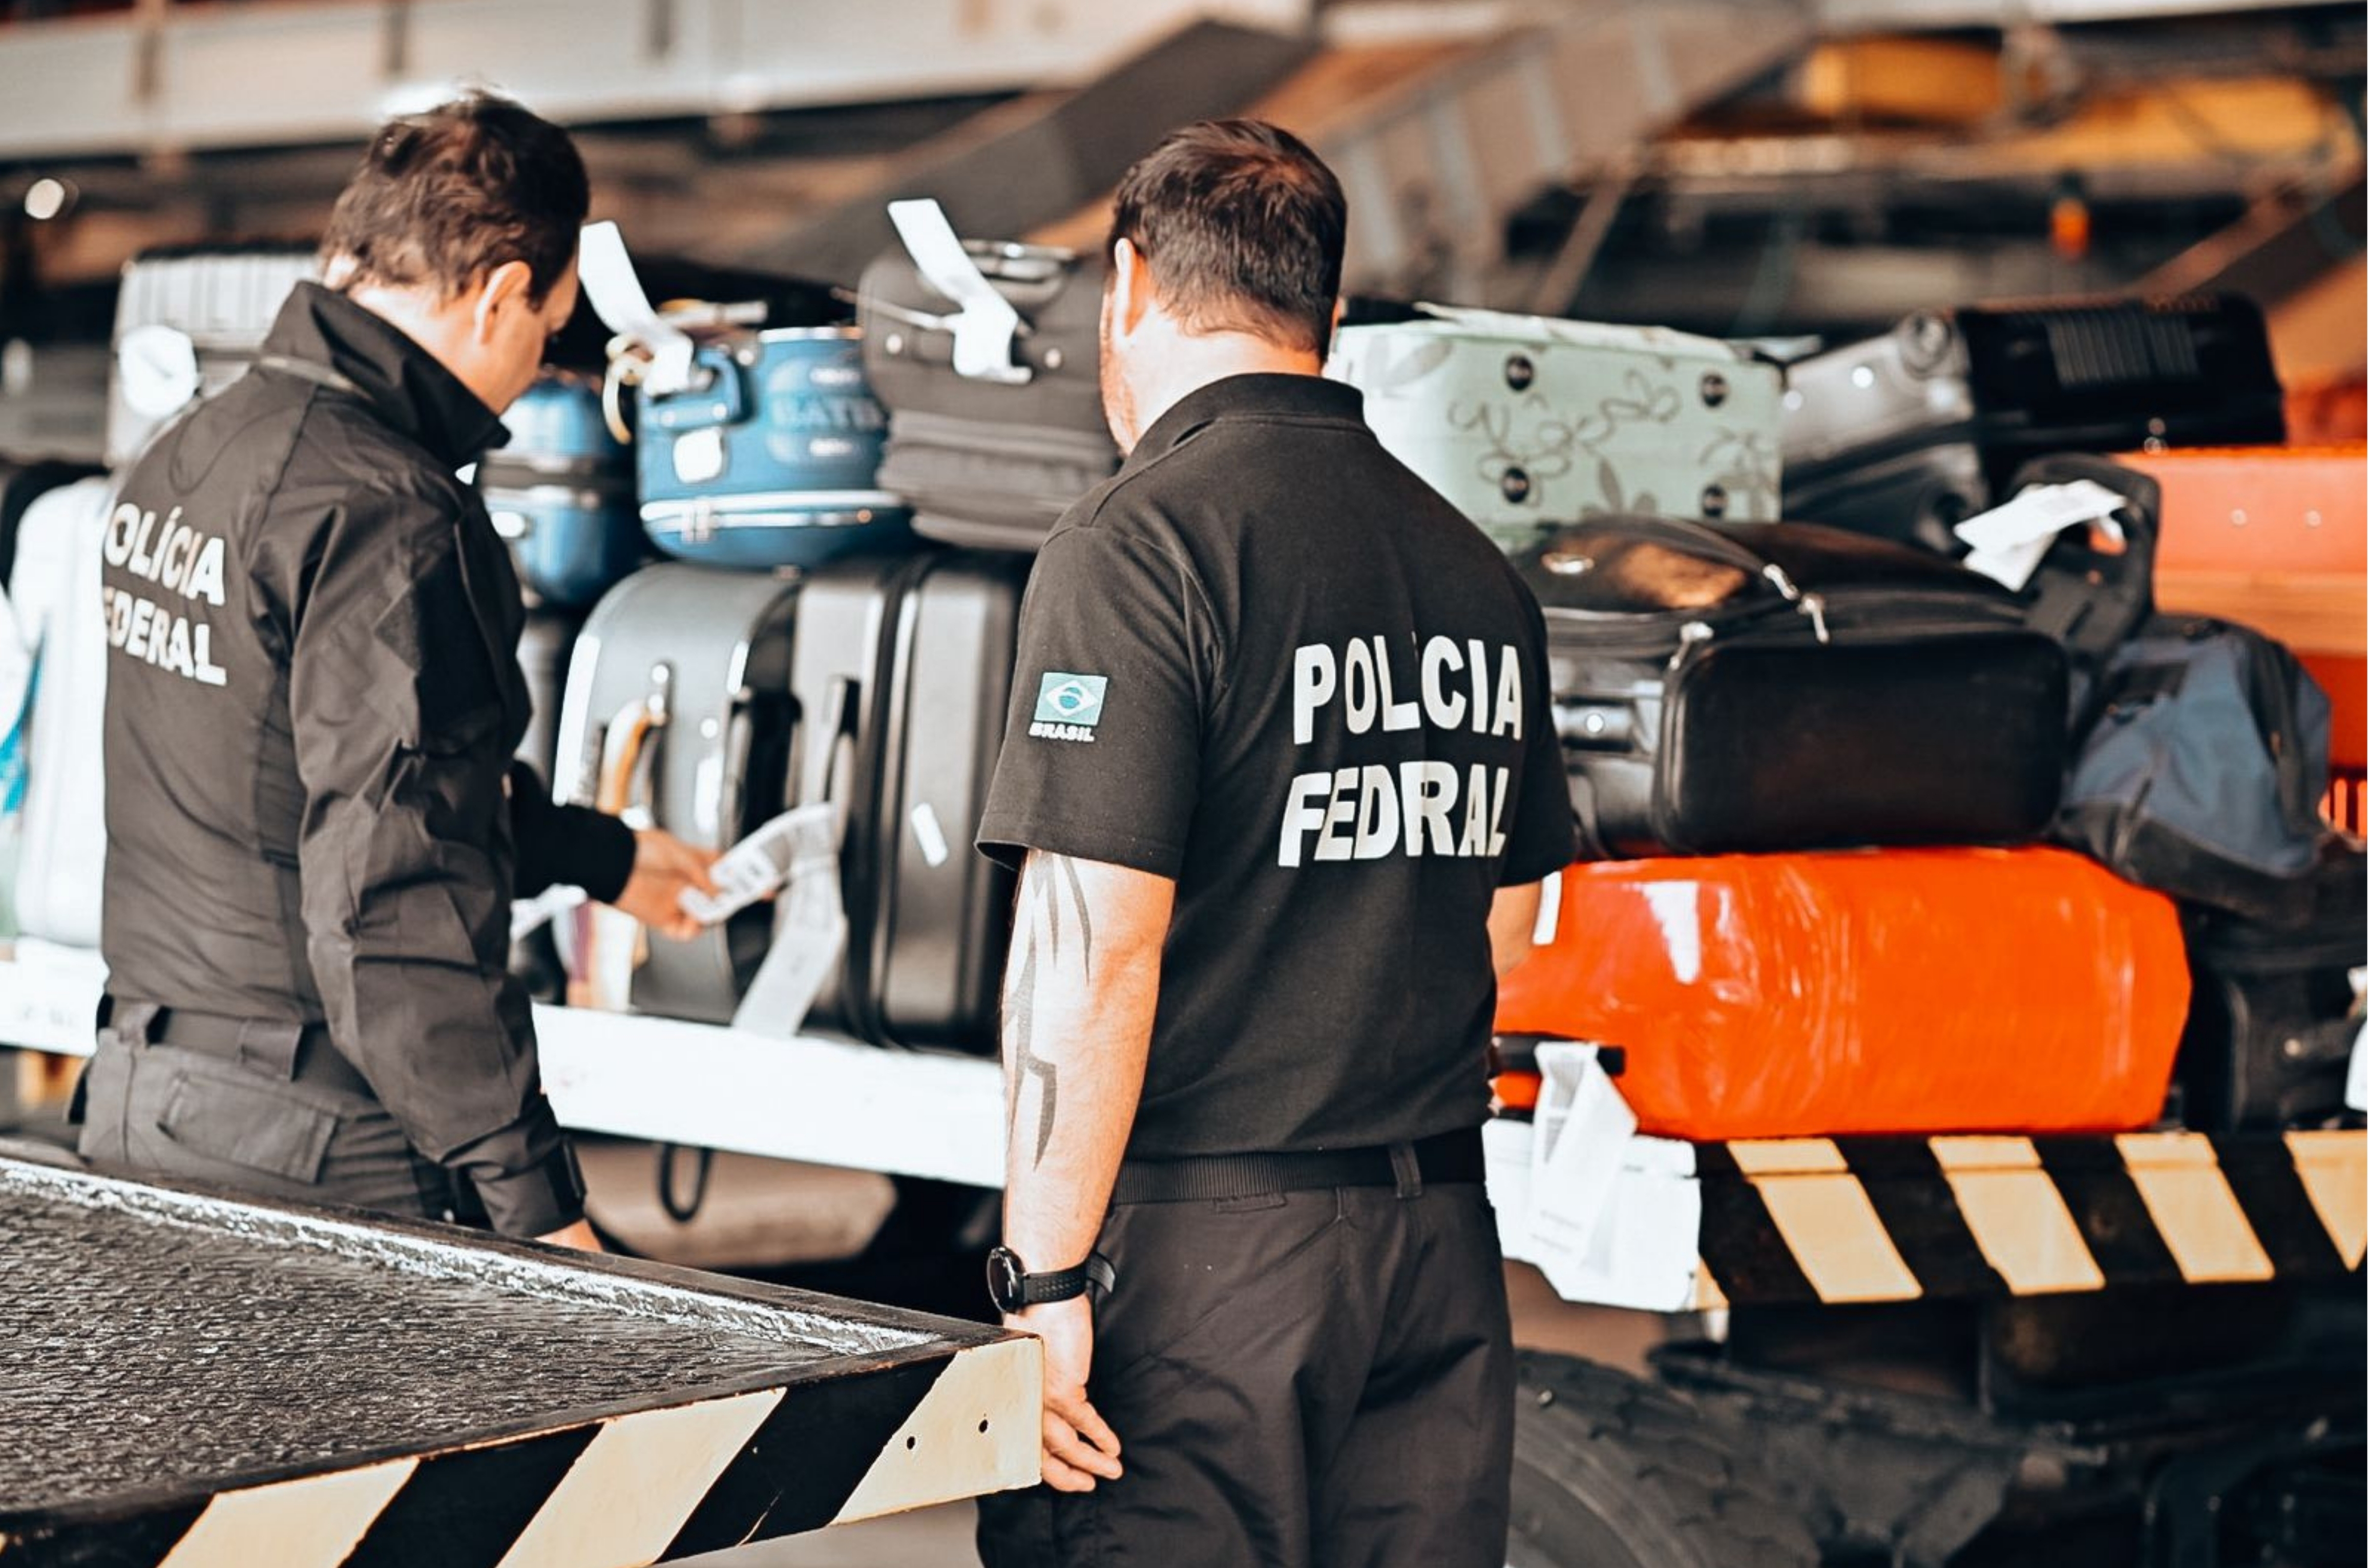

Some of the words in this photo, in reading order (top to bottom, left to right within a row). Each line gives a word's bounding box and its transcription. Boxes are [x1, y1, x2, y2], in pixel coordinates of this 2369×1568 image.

[104, 503, 225, 606] OLÍCIA
[103, 586, 227, 686] DERAL
[1029, 722, 1095, 742] BRASIL
[1293, 631, 1523, 746] POLCIA
